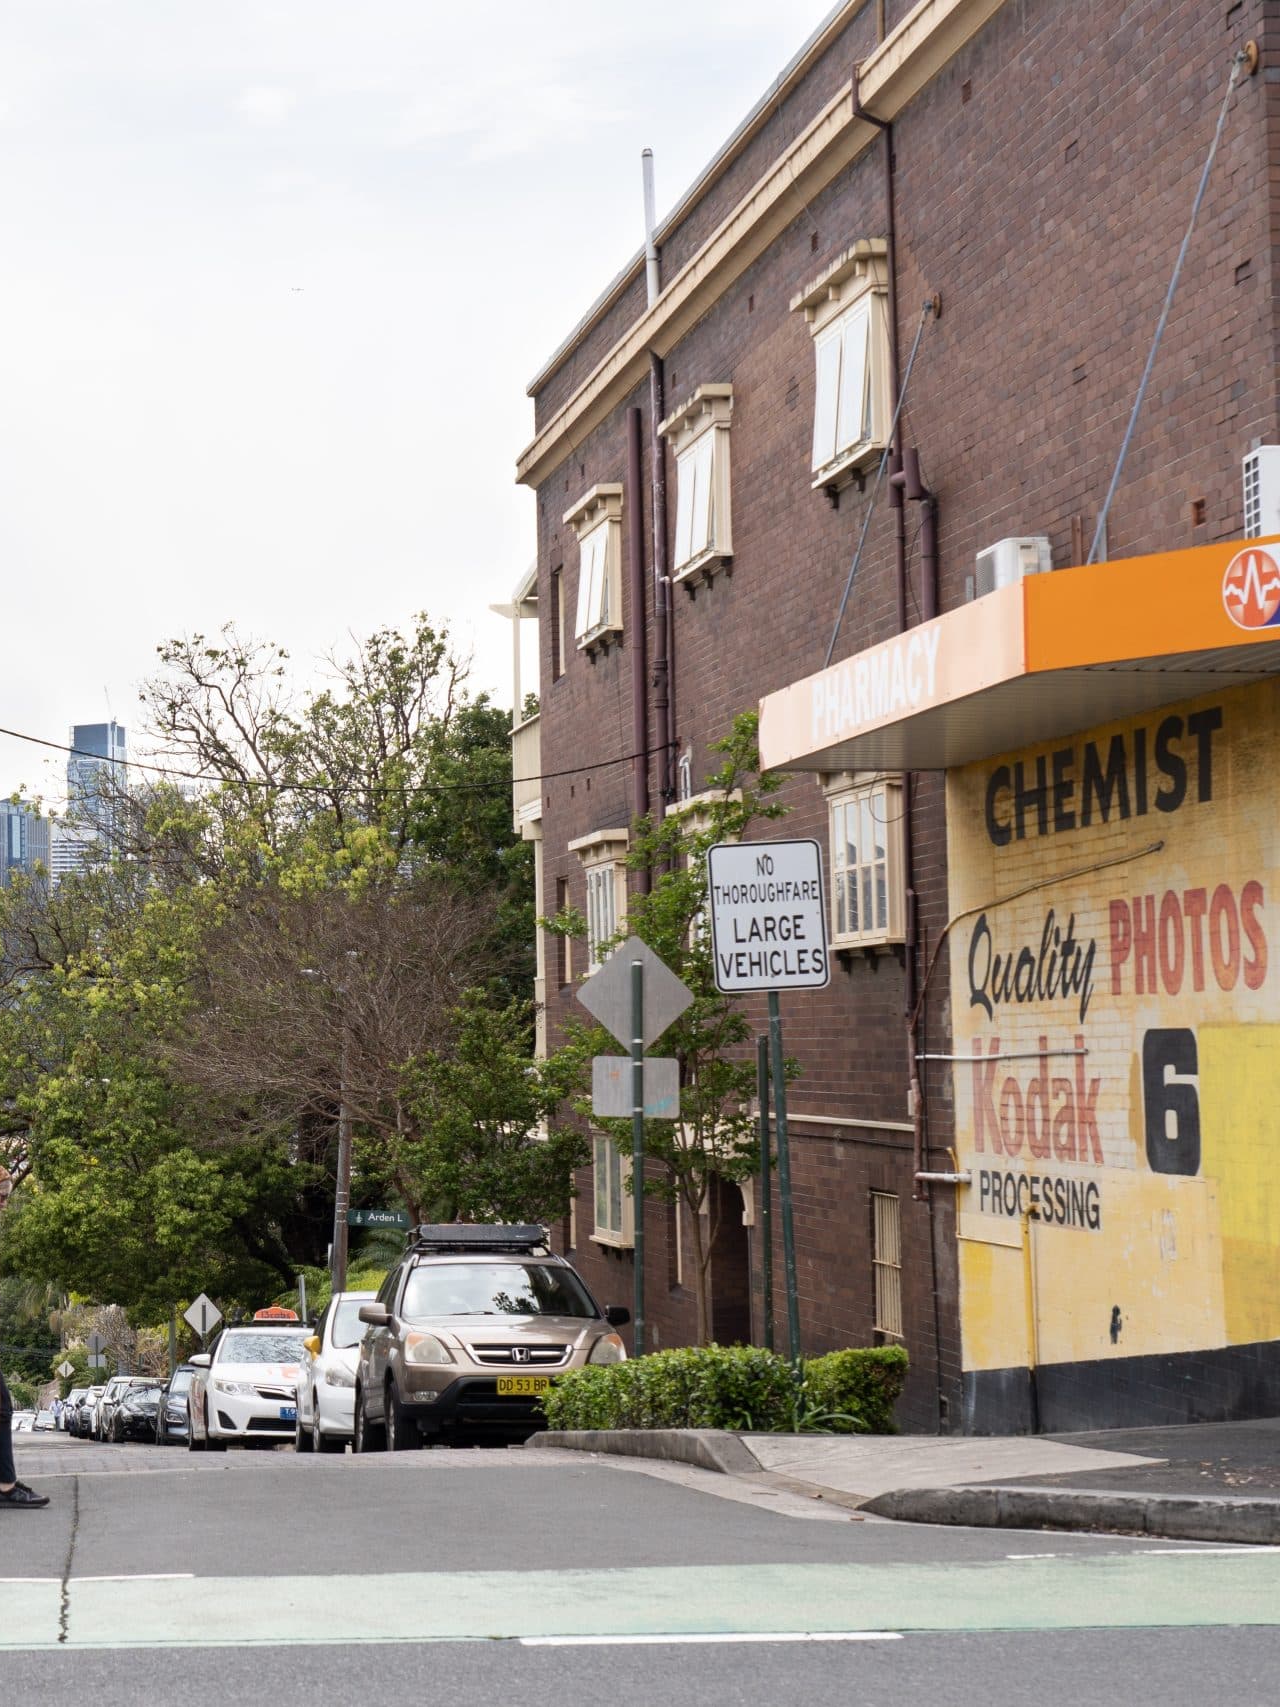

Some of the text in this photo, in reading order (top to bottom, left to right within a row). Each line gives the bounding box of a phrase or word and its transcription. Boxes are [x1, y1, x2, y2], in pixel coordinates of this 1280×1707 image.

[811, 623, 941, 743] PHARMACY
[985, 706, 1223, 847] CHEMIST
[714, 880, 819, 905] THOROUGHFARE
[756, 855, 774, 876] NO
[733, 914, 806, 944] LARGE
[968, 880, 1268, 1024] Quality PHOTOS
[720, 948, 824, 978] VEHICLES
[972, 1034, 1105, 1166] Kodak
[1142, 1027, 1201, 1177] 6
[368, 1212, 395, 1222] Arden
[979, 1169, 1101, 1231] PROCESSING
